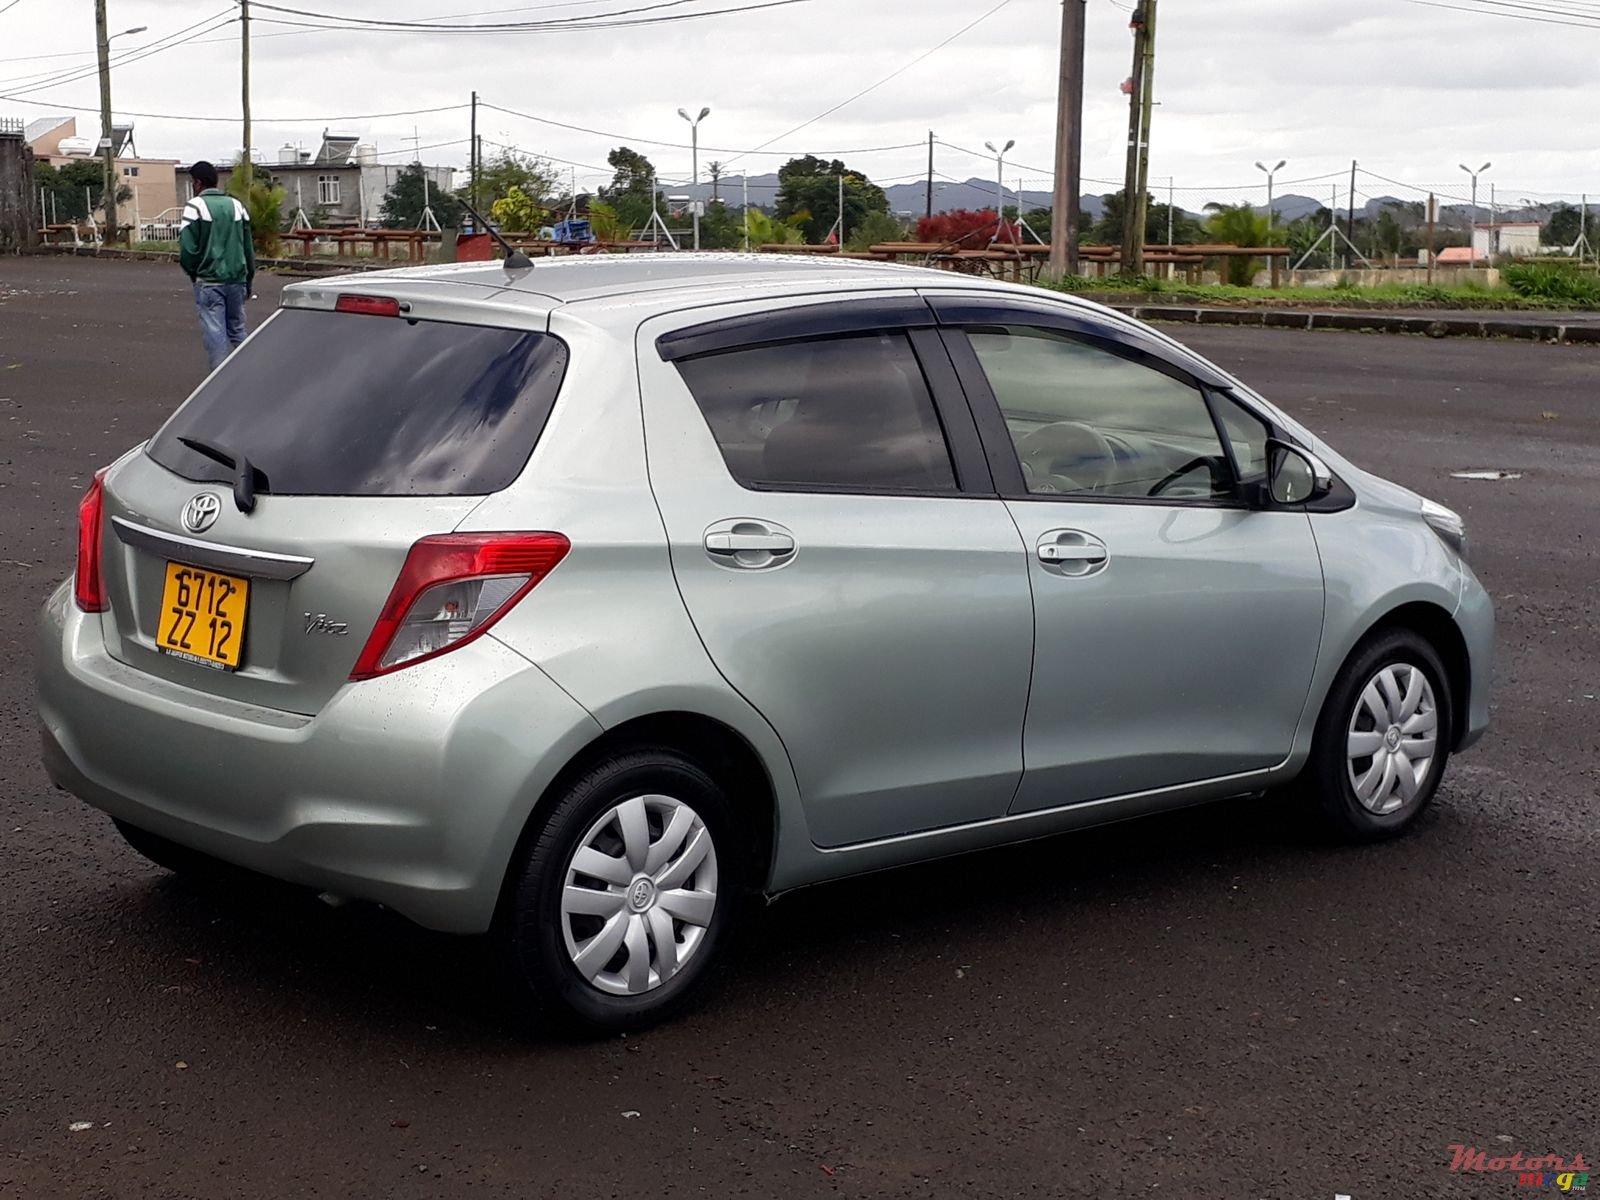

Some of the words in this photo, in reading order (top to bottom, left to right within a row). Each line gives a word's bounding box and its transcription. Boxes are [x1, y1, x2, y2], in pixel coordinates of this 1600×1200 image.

[177, 569, 231, 618] 6712
[166, 607, 197, 650] ZZ
[209, 617, 232, 660] 12
